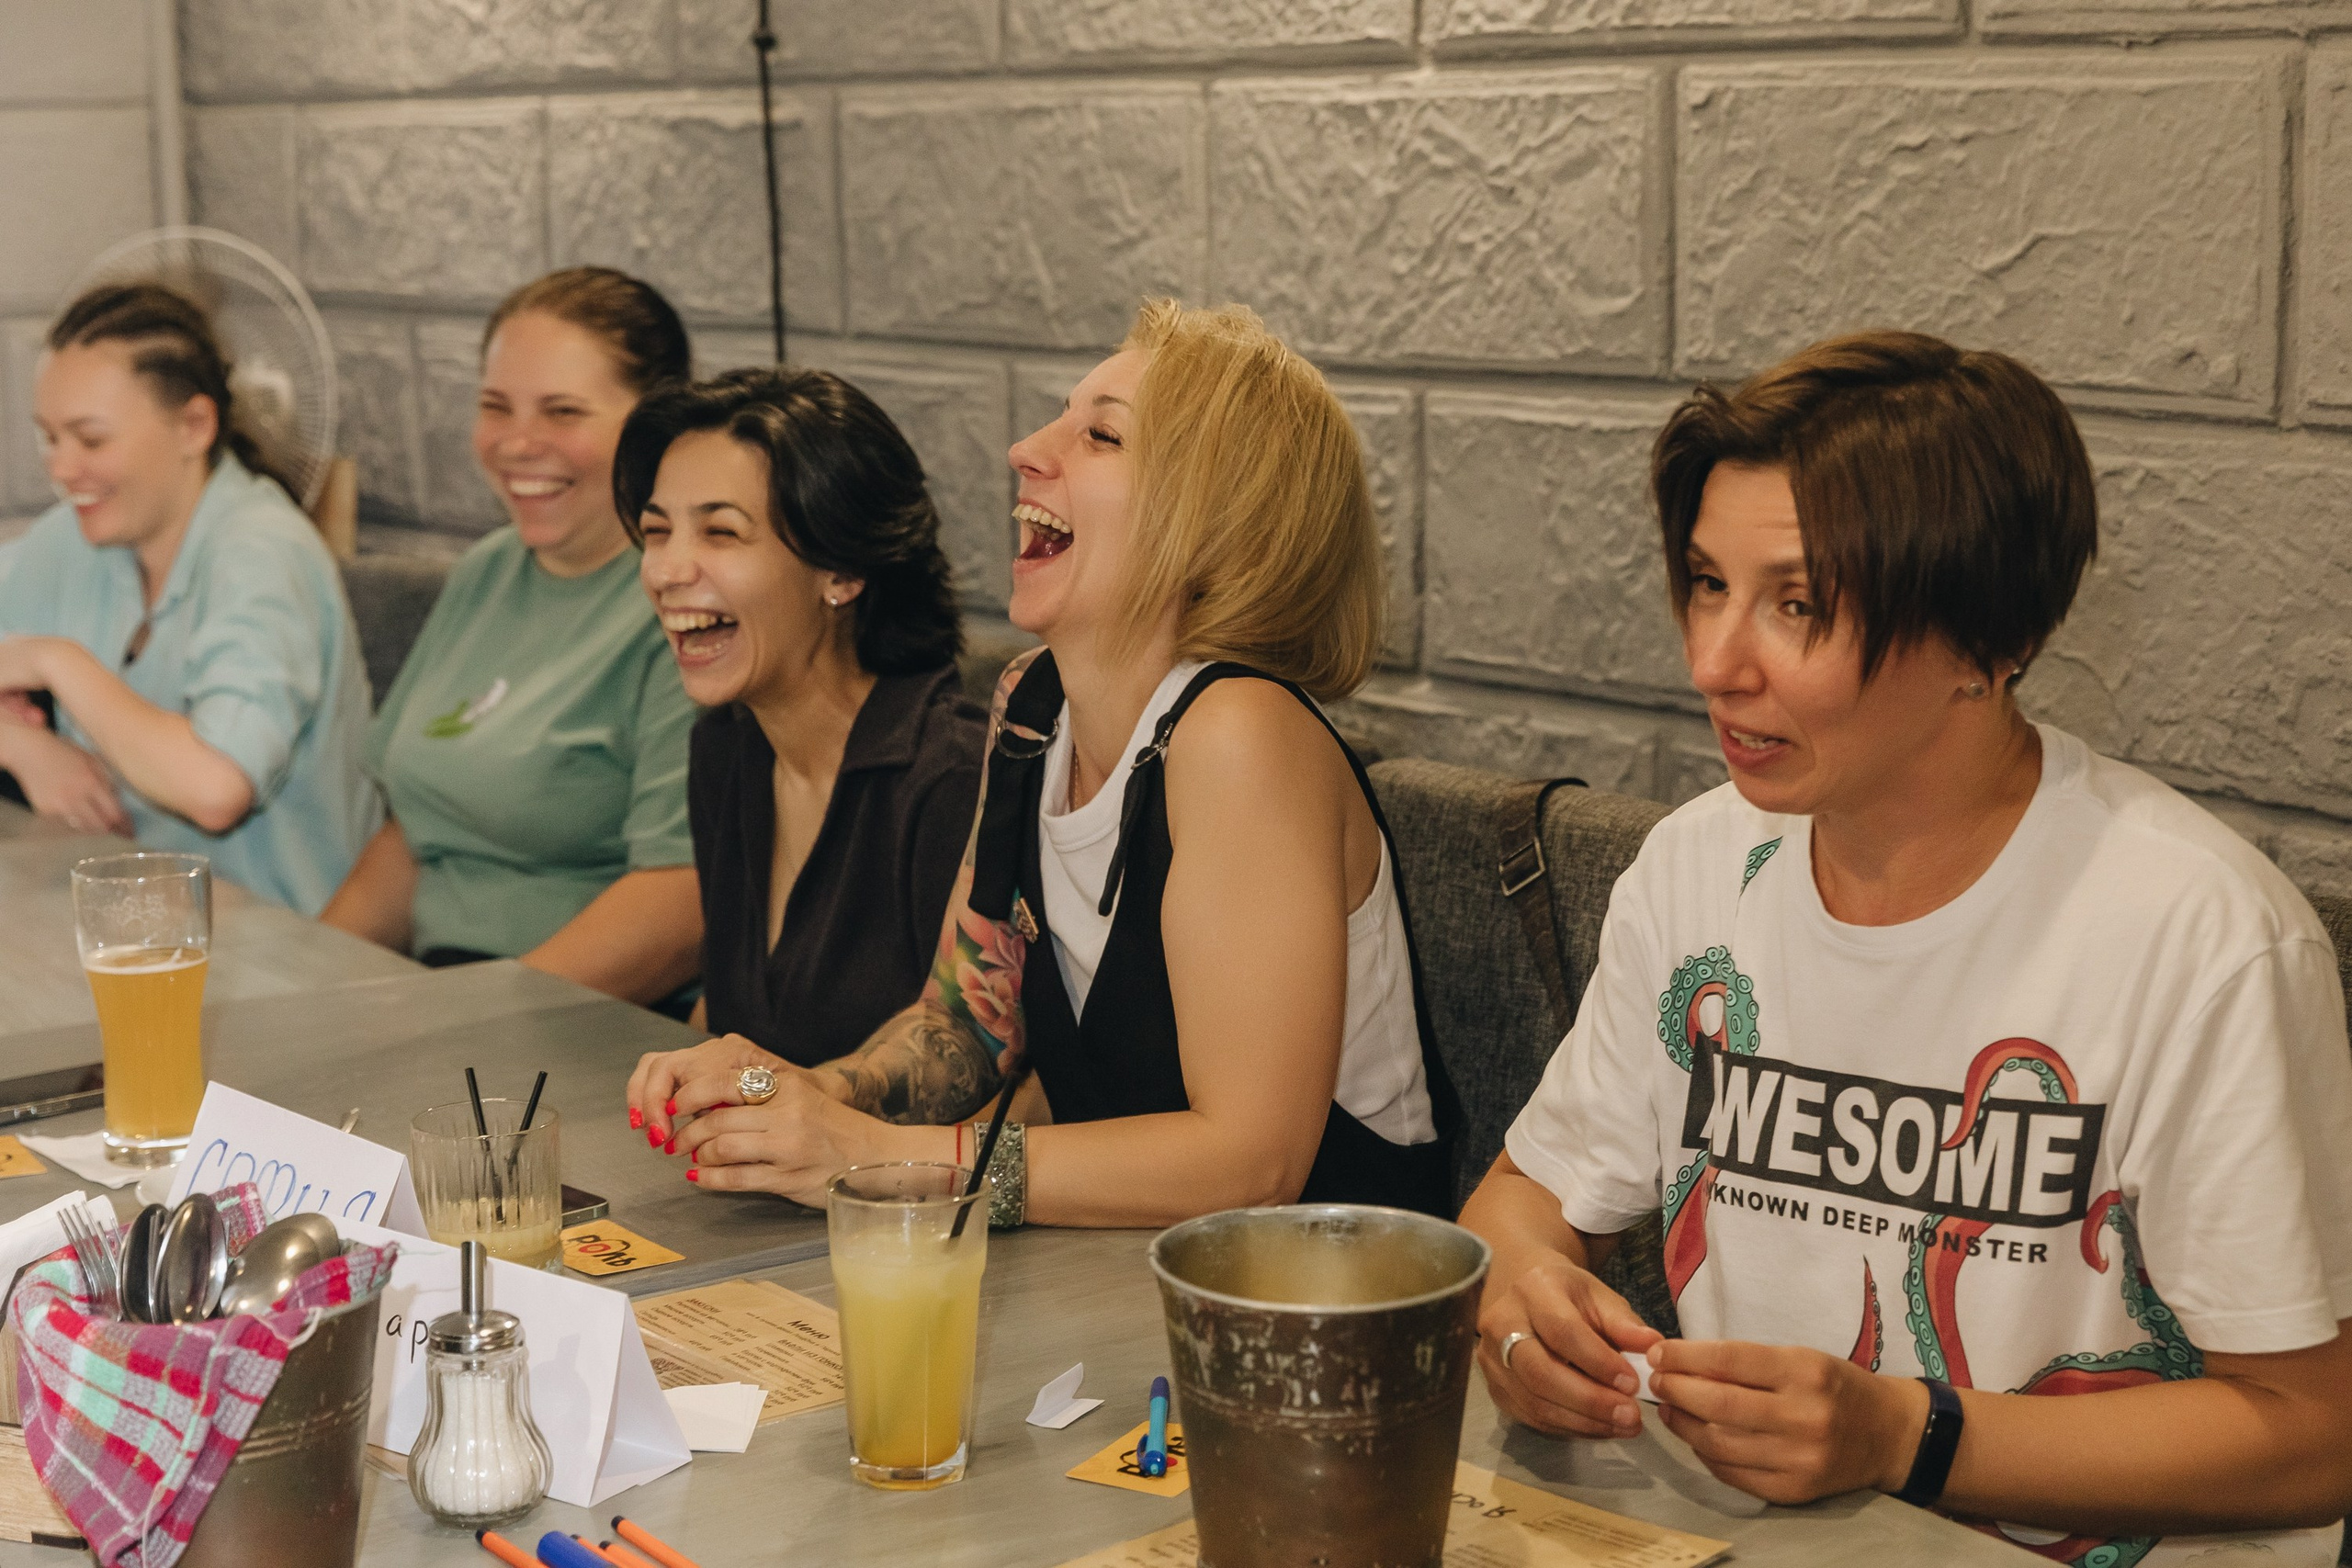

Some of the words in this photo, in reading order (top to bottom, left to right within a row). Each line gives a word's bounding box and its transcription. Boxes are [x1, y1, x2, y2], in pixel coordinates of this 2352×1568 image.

[1700, 1054, 2084, 1217] WESOME
[1823, 1205, 1889, 1236] DEEP
[1897, 1222, 2048, 1263] MONSTER
[787, 1320, 830, 1339] Меню
